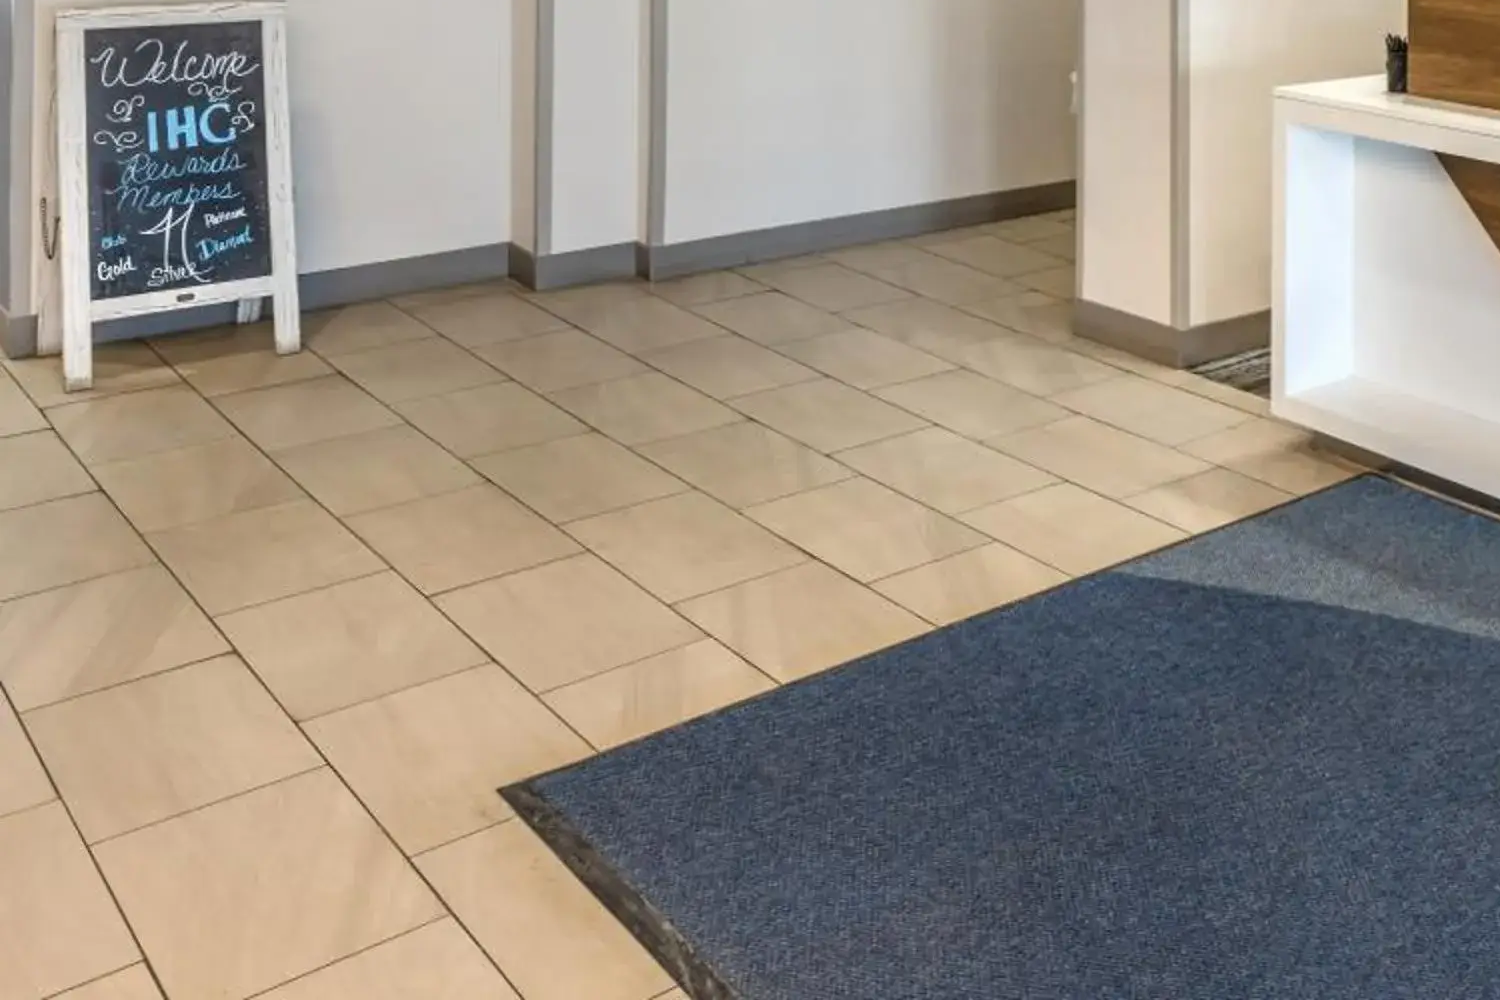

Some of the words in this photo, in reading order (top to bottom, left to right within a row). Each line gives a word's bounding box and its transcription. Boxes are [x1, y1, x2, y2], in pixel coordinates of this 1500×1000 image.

[89, 38, 260, 90] Welcome
[117, 148, 247, 185] Rewards
[104, 182, 242, 213] Members
[97, 255, 138, 281] Gold
